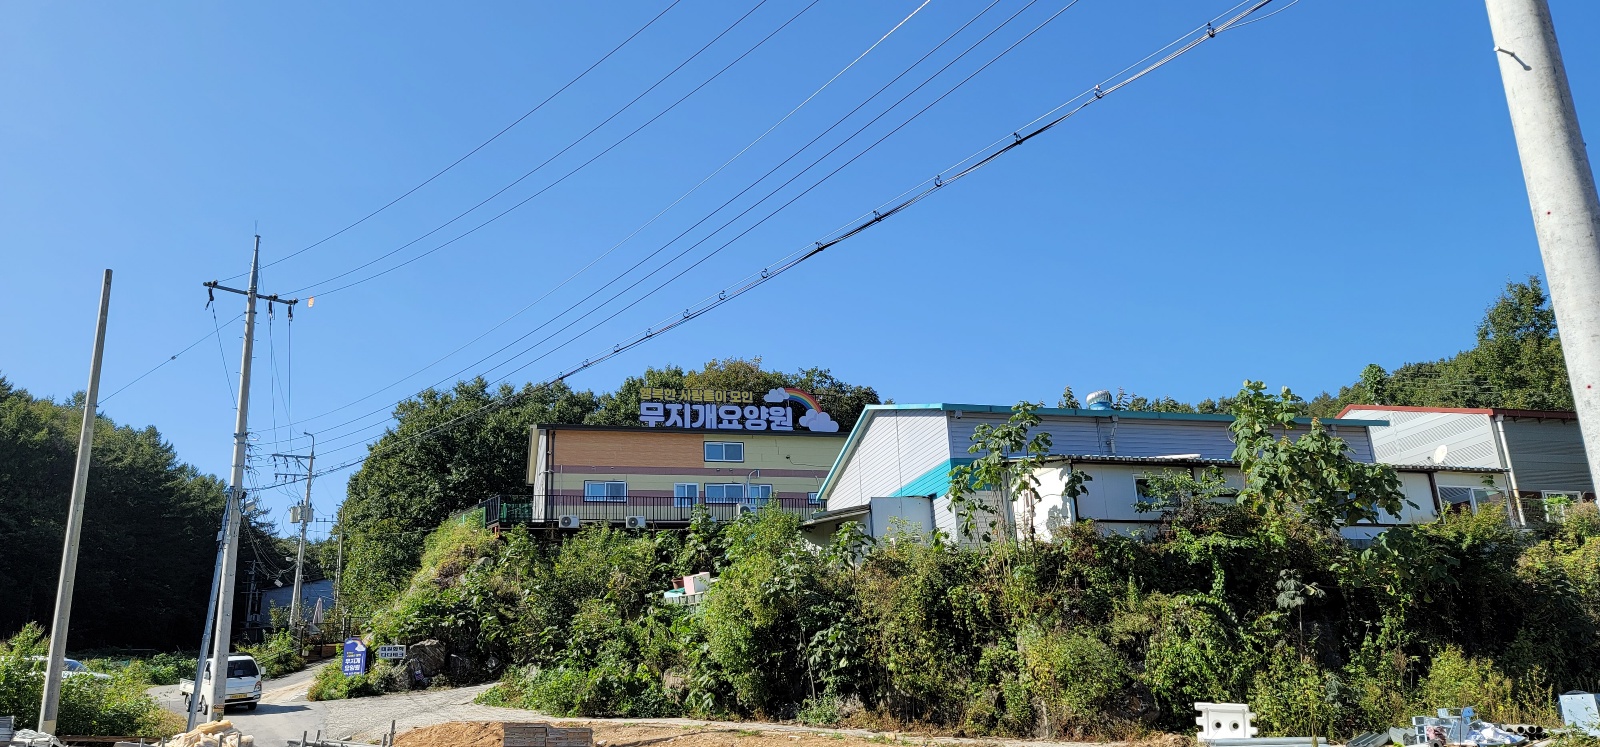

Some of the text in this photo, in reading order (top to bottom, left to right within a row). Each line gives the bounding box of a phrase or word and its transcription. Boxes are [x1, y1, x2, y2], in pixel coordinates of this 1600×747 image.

[640, 387, 753, 403] 행복한 사람들이 모인
[639, 402, 794, 431] 무지개요양원
